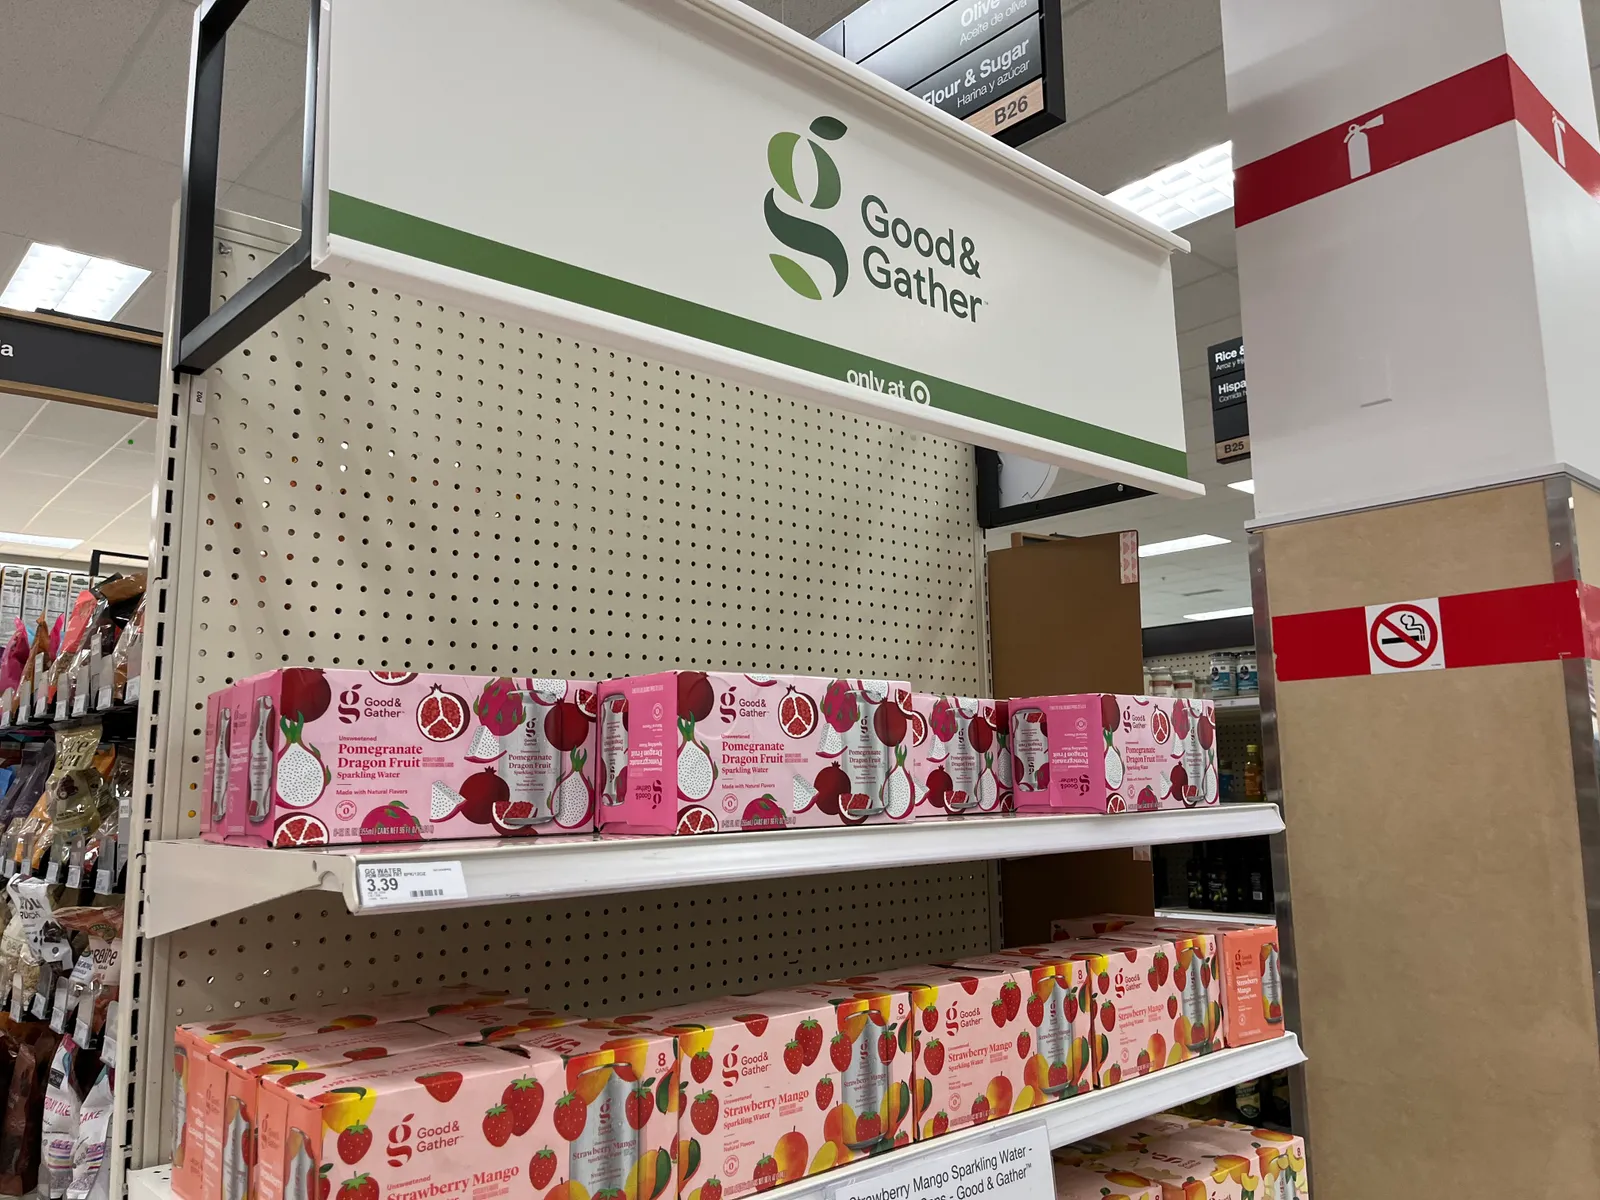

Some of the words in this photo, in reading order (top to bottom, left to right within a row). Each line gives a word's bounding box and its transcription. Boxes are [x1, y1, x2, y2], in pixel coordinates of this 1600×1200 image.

[960, 21, 988, 45] Aceite
[990, 12, 1003, 26] de
[964, 69, 976, 87] &
[979, 39, 1029, 78] Sugar
[957, 83, 987, 108] Harina
[988, 81, 996, 93] y
[996, 60, 1029, 86] azúcar
[994, 95, 1028, 126] B26
[861, 194, 981, 279] Good&
[1215, 349, 1237, 363] Rice
[846, 369, 885, 394] only
[888, 380, 905, 399] at
[1224, 441, 1244, 453] B25
[364, 697, 401, 708] Good&
[739, 698, 766, 708] Good&
[338, 743, 423, 757] Pomegranate
[630, 749, 643, 757] Fruit
[643, 748, 663, 757] Dragon
[722, 741, 784, 754] Pomegranate
[1067, 750, 1088, 758] Dragon
[338, 757, 387, 770] Dragon
[389, 757, 421, 768] Fruit
[508, 754, 552, 762] Pomegranate
[722, 754, 758, 766] Dragon
[760, 754, 783, 764] Fruit
[1126, 755, 1143, 763] Dragon
[508, 762, 533, 770] Dragon
[721, 766, 750, 776] Sparkling
[751, 766, 768, 774] Water
[337, 771, 376, 780] Sparkling
[377, 771, 400, 779] Water
[366, 877, 398, 891] 3.39
[898, 1003, 904, 1015] 8
[959, 1007, 980, 1019] Good&
[1118, 1008, 1147, 1021] Strawberry
[1147, 1004, 1164, 1014] Mango
[741, 1051, 769, 1066] Good&
[948, 1046, 988, 1062] Strawberry
[989, 1041, 1013, 1054] Mango
[658, 1053, 666, 1066] 8
[723, 1098, 777, 1119] Strawberry
[778, 1090, 809, 1105] Mango
[723, 1115, 753, 1130] Sparkling
[754, 1112, 770, 1121] Water
[417, 1120, 460, 1139] Good&
[572, 1145, 611, 1160] Strawberry
[849, 1184, 910, 1200] awberry
[913, 1171, 949, 1192] Mango
[950, 1155, 998, 1181] Sparkling
[998, 1147, 1026, 1166] Water
[387, 1178, 470, 1200] Strawberry
[472, 1165, 519, 1186] Mango
[387, 1174, 431, 1191] Unsweetened
[956, 1178, 985, 1200] Good
[986, 1177, 994, 1190] &
